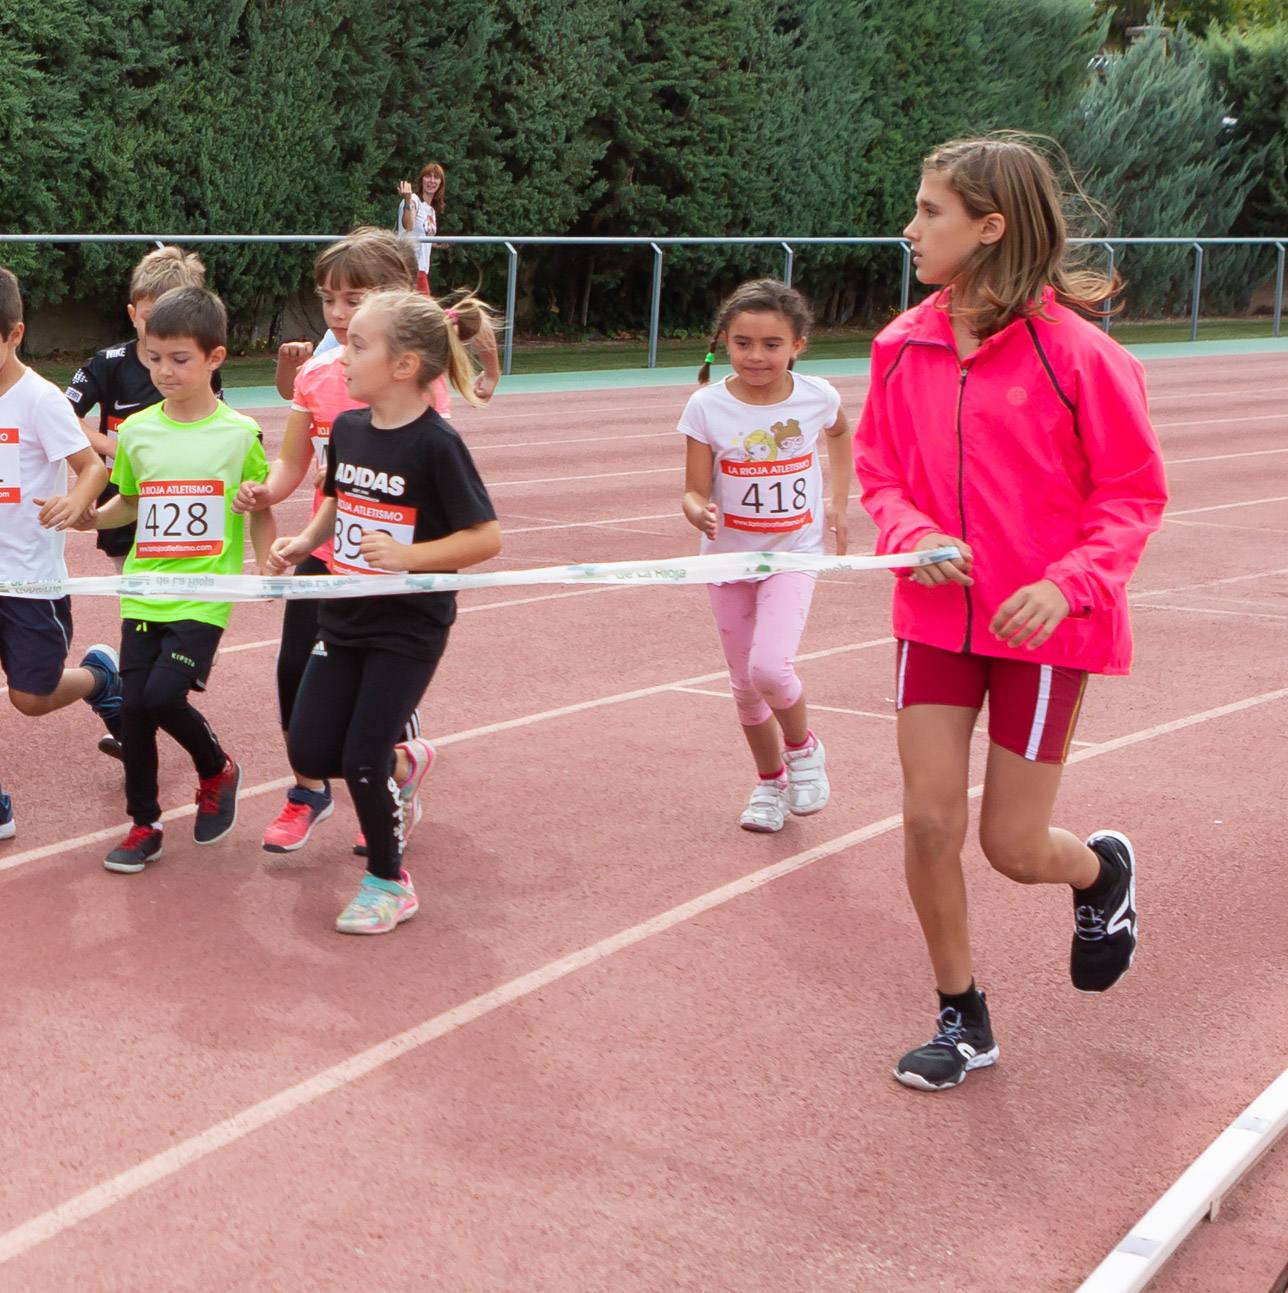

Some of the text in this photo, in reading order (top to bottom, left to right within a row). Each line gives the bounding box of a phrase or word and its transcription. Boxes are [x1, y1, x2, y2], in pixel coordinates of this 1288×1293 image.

[335, 462, 406, 497] ADIDAS
[740, 465, 769, 476] RIOJA
[770, 459, 811, 474] ATLETISMO
[166, 484, 214, 495] ATLETISMO
[741, 477, 807, 514] 418
[145, 502, 208, 537] 428
[353, 504, 404, 522] ATLETISMO
